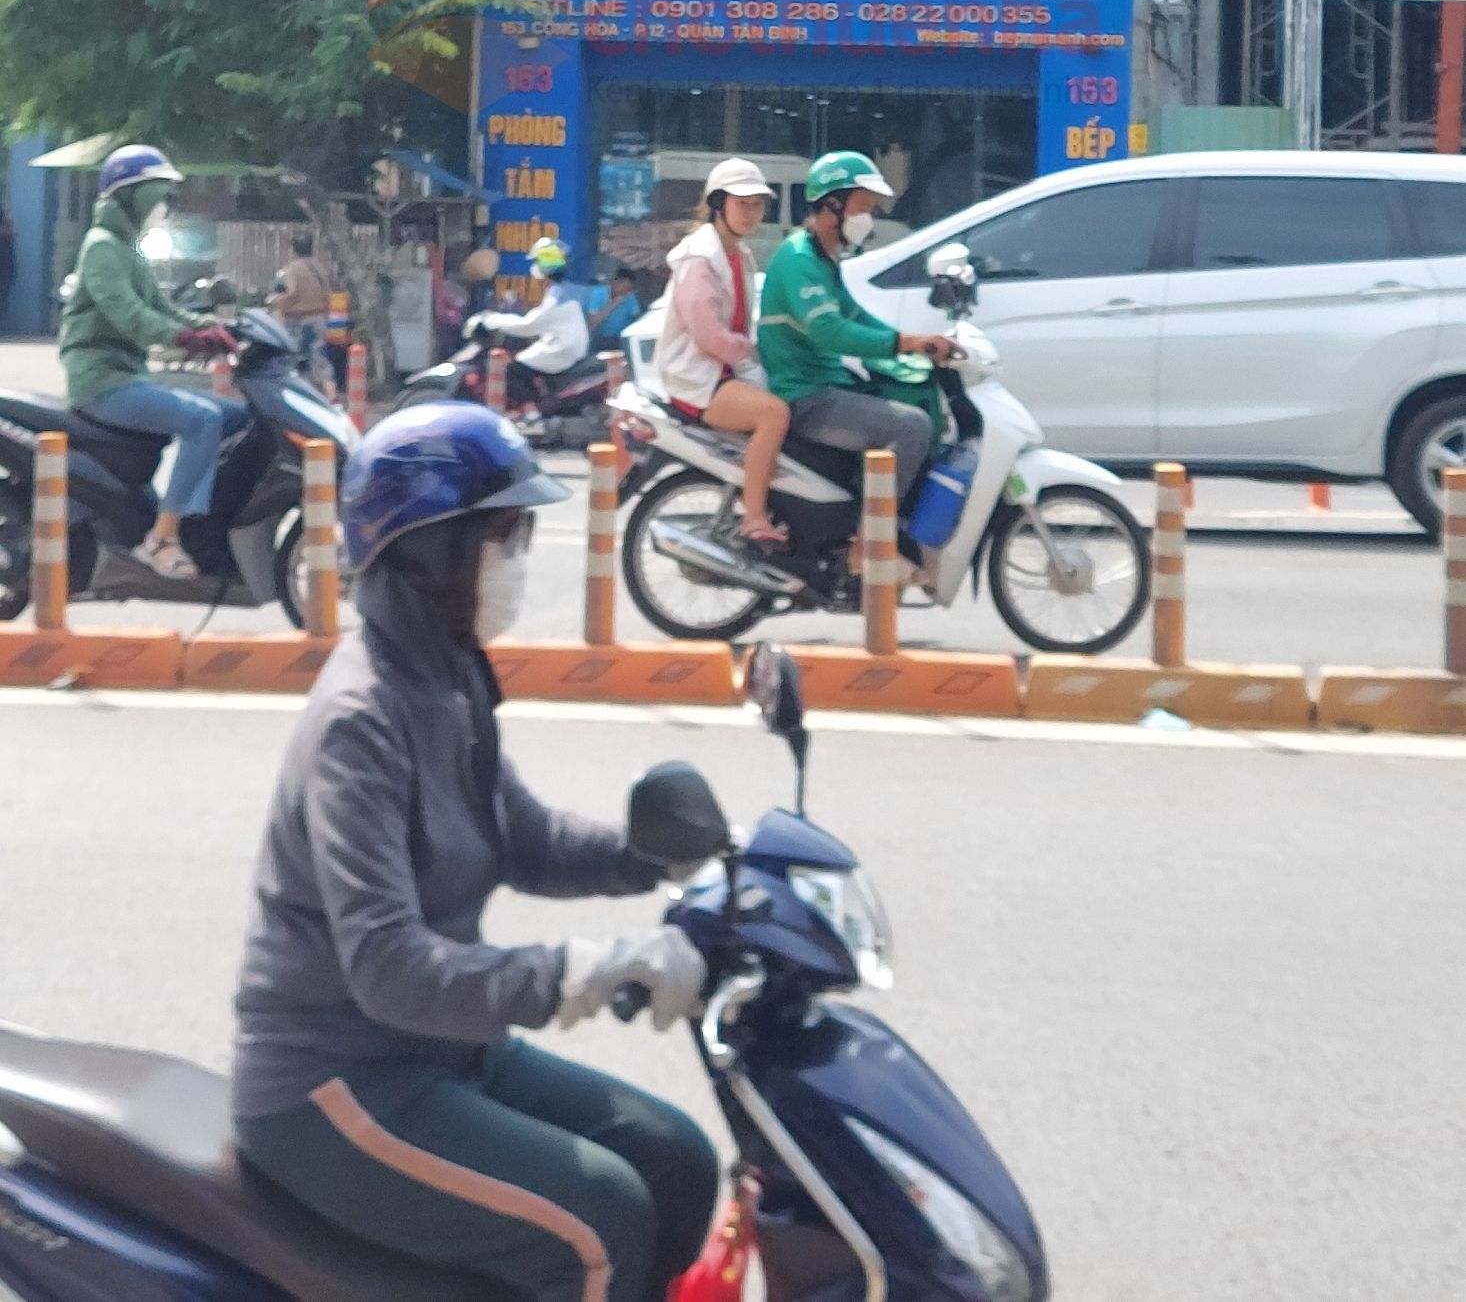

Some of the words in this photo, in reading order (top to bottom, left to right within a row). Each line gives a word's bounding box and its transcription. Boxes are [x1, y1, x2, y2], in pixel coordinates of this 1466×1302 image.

[652, 0, 715, 18] 0901
[726, 0, 778, 19] 308
[787, 2, 839, 21] 286
[1002, 6, 1051, 24] 355
[506, 65, 553, 93] 153
[1066, 76, 1119, 105] 153
[1066, 115, 1116, 159] BẾP
